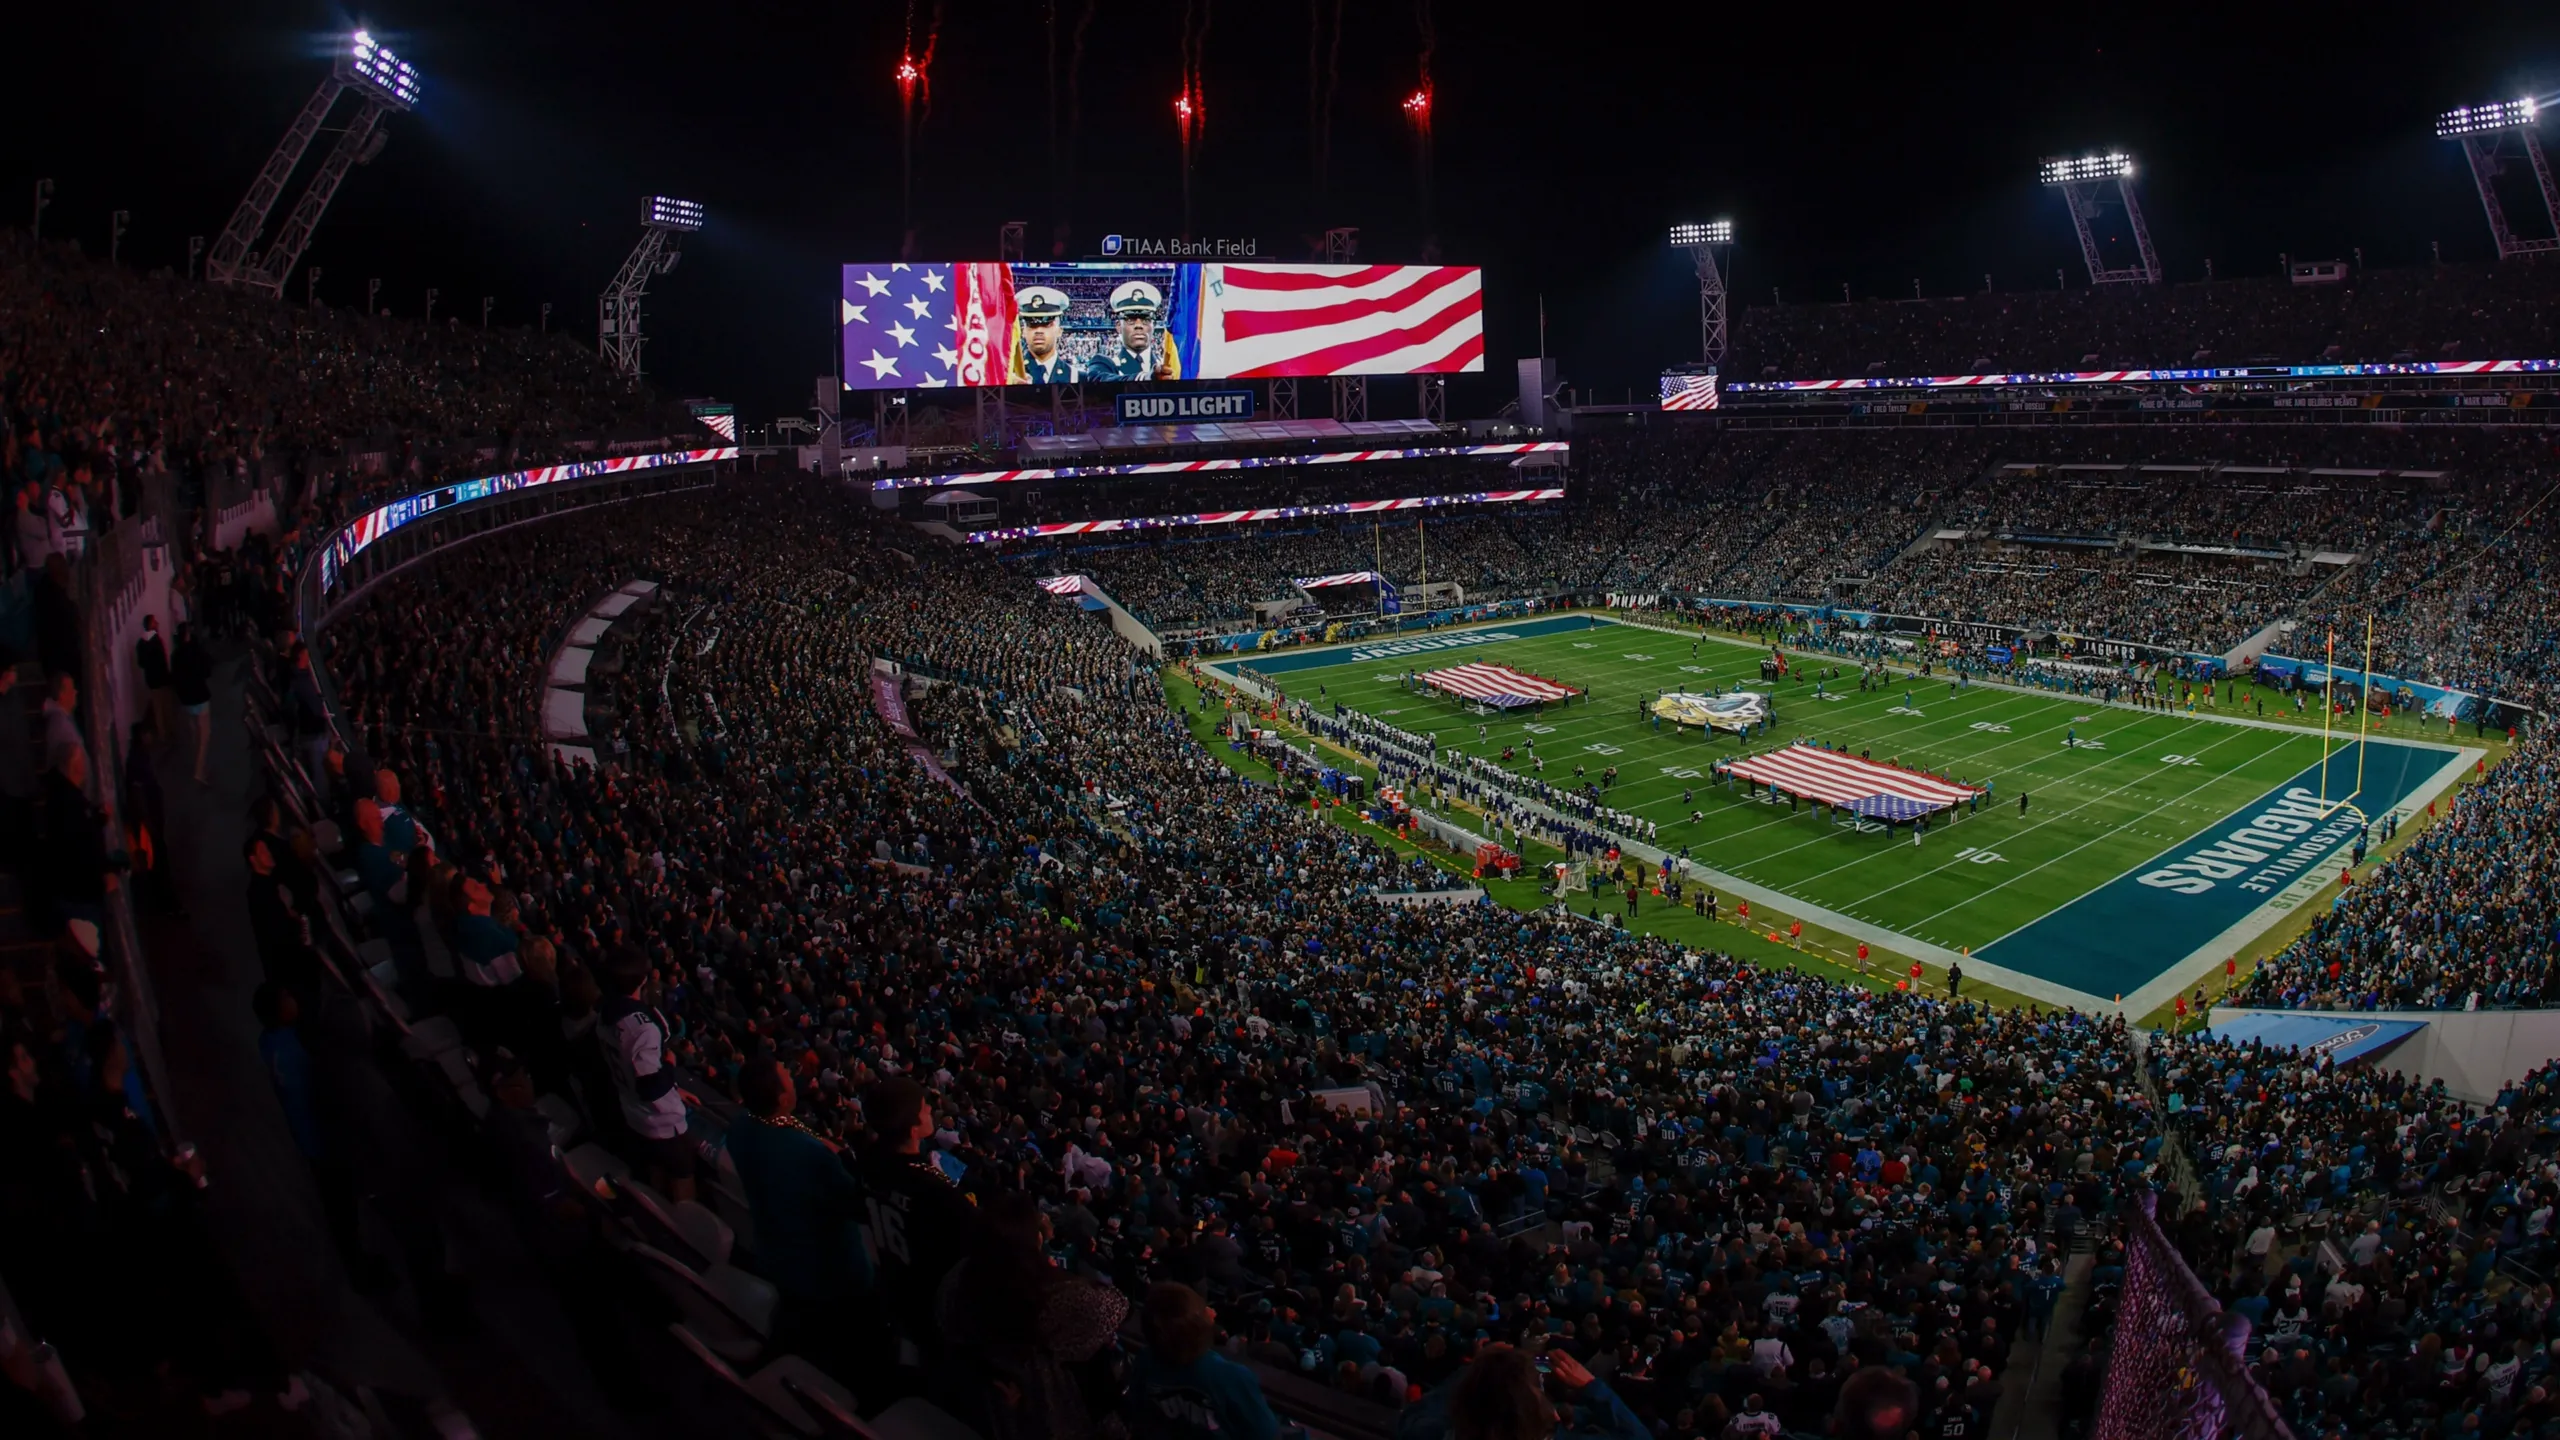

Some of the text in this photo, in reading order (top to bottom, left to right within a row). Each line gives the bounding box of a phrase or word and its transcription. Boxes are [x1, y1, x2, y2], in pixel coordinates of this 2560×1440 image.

[1123, 237, 1256, 256] TIAA Bank Field
[1125, 396, 1246, 417] BUD LIGHT
[1888, 405, 1907, 413] TAYLOR
[1351, 632, 1520, 662] JAGUARS
[2083, 640, 2136, 661] JAGUARS
[1583, 743, 1624, 756] 50
[2136, 787, 2338, 894] JAGUARS
[1954, 847, 2001, 864] 10
[2238, 809, 2369, 894] JACKSONVILLE
[2269, 893, 2304, 909] US
[2315, 1030, 2364, 1054] Ford
[1677, 1155, 1689, 1167] 16
[865, 1196, 911, 1267] 16
[1342, 1234, 1354, 1248] 16
[2278, 1320, 2301, 1334] 27
[1942, 1423, 1965, 1437] 50
